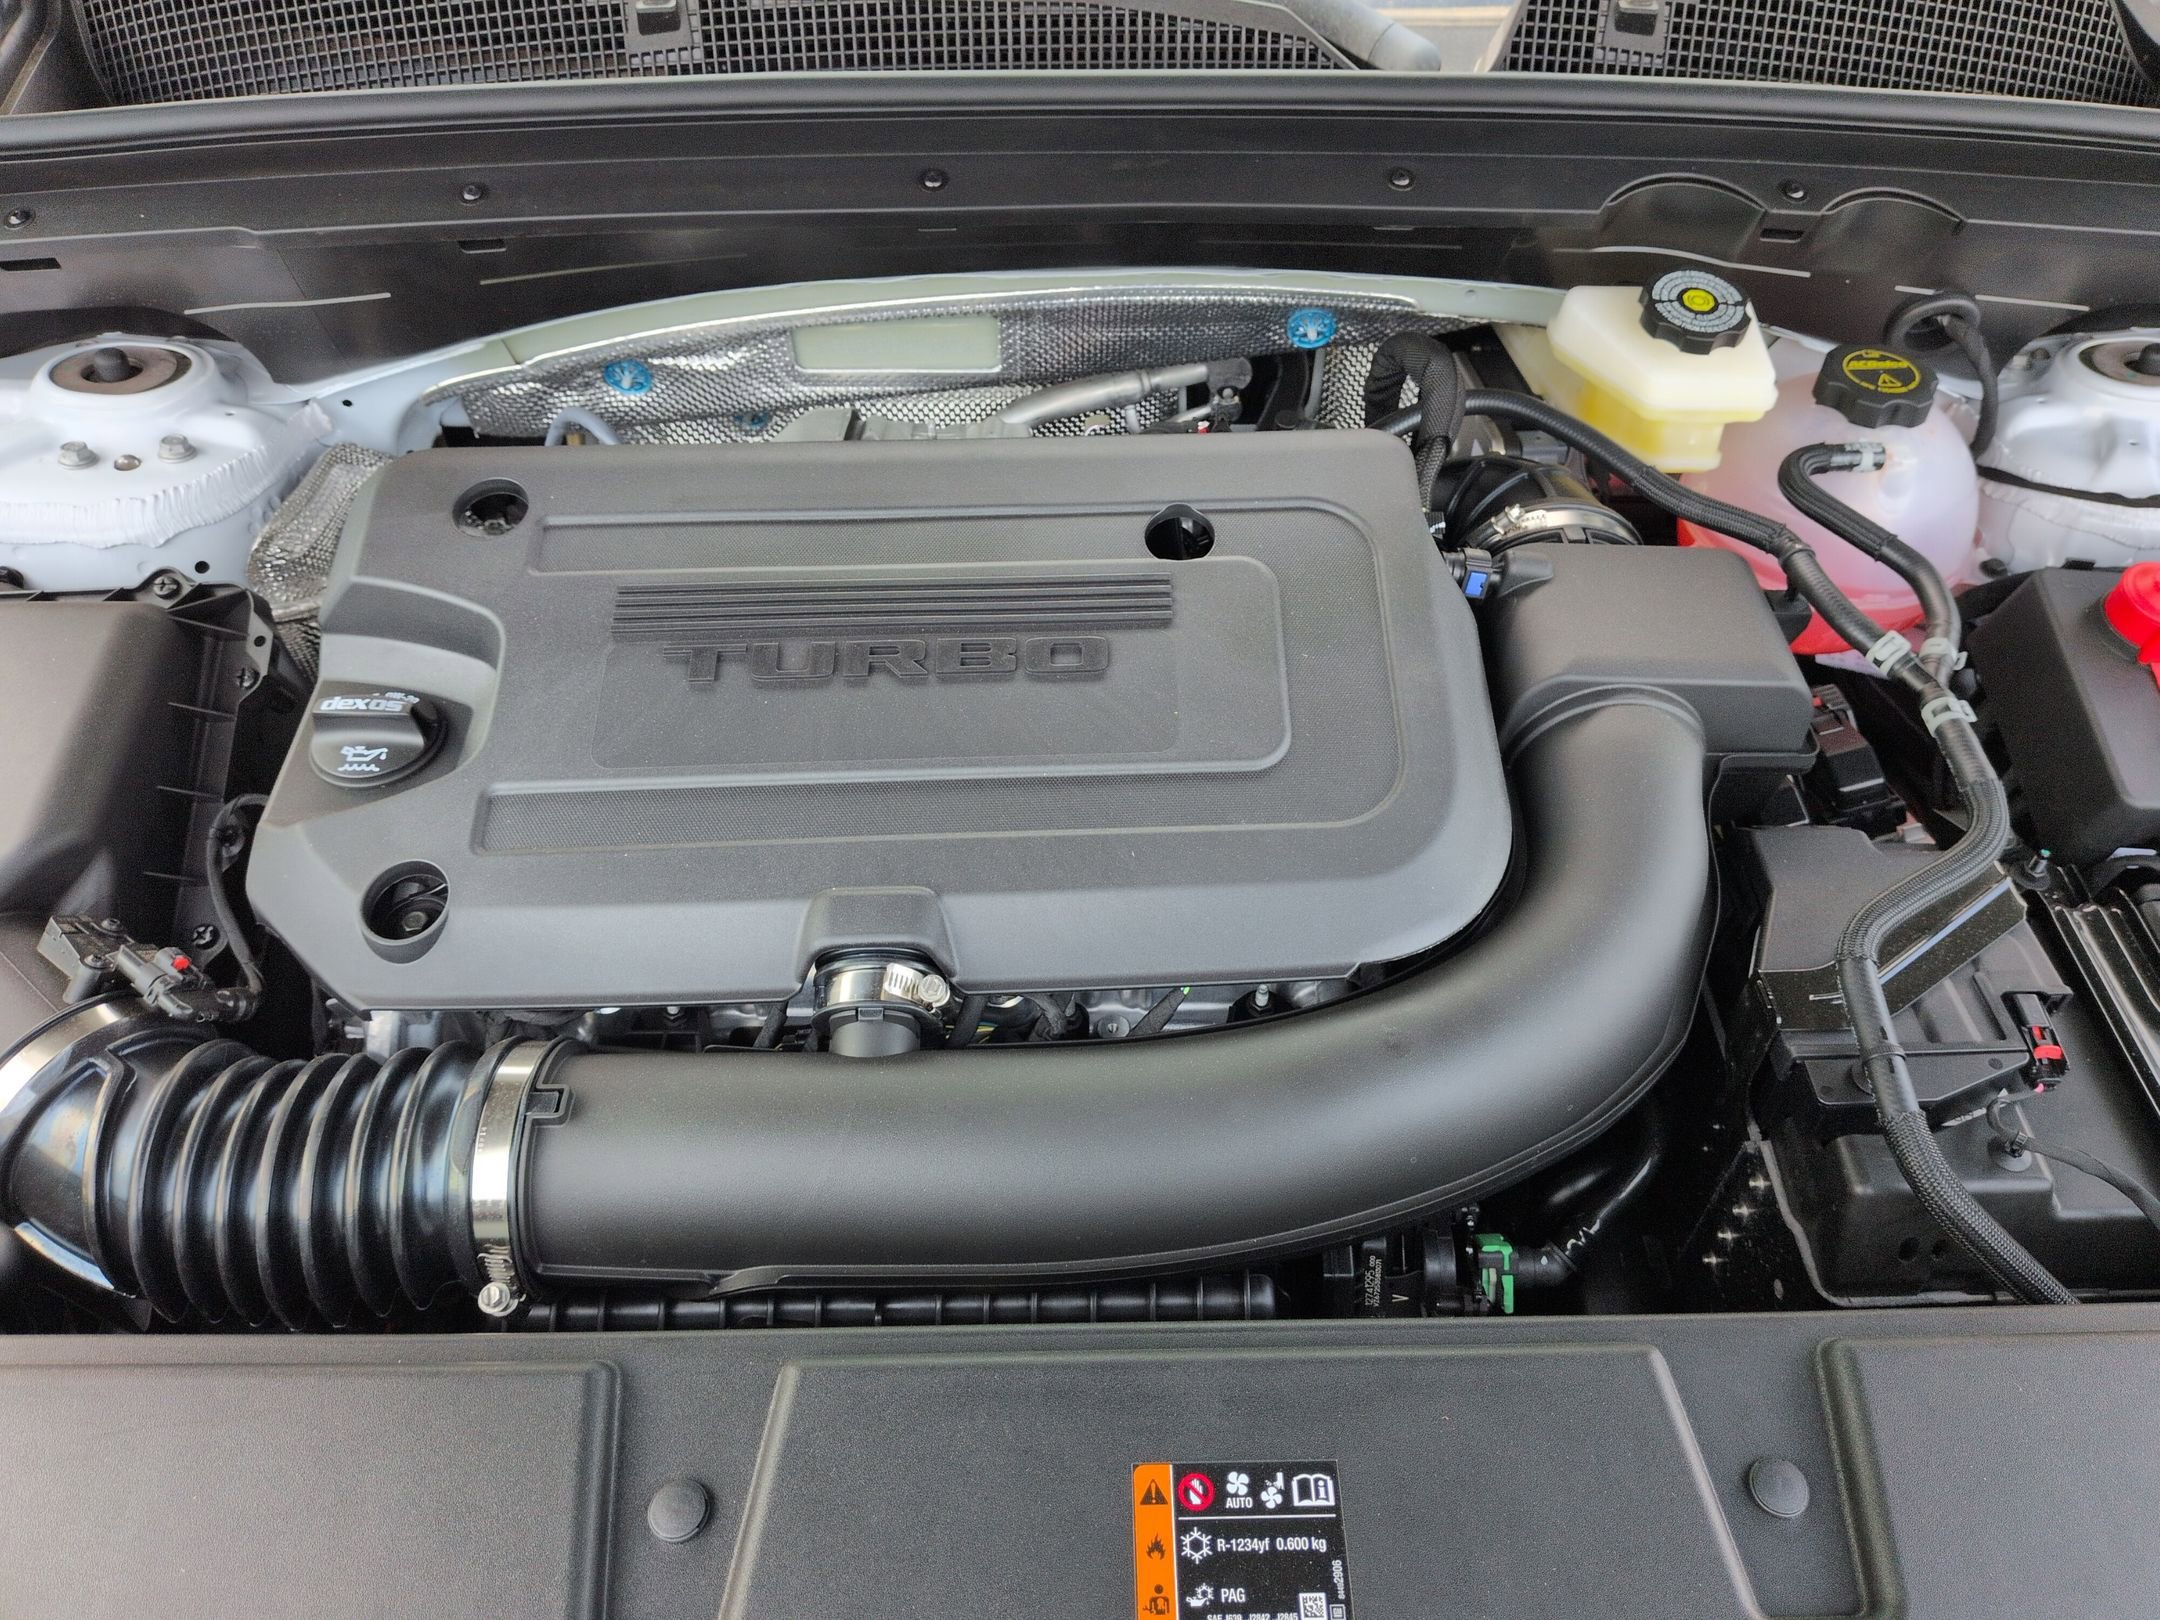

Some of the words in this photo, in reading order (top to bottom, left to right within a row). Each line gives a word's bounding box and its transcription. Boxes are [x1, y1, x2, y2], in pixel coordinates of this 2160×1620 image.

[663, 636, 1111, 685] TURBO
[320, 696, 404, 711] dexos
[1225, 1496, 1254, 1509] AUTO
[1217, 1538, 1270, 1554] R-1234yf
[1275, 1537, 1309, 1551] 0.600
[1311, 1536, 1328, 1553] kg
[1220, 1588, 1246, 1603] PAG
